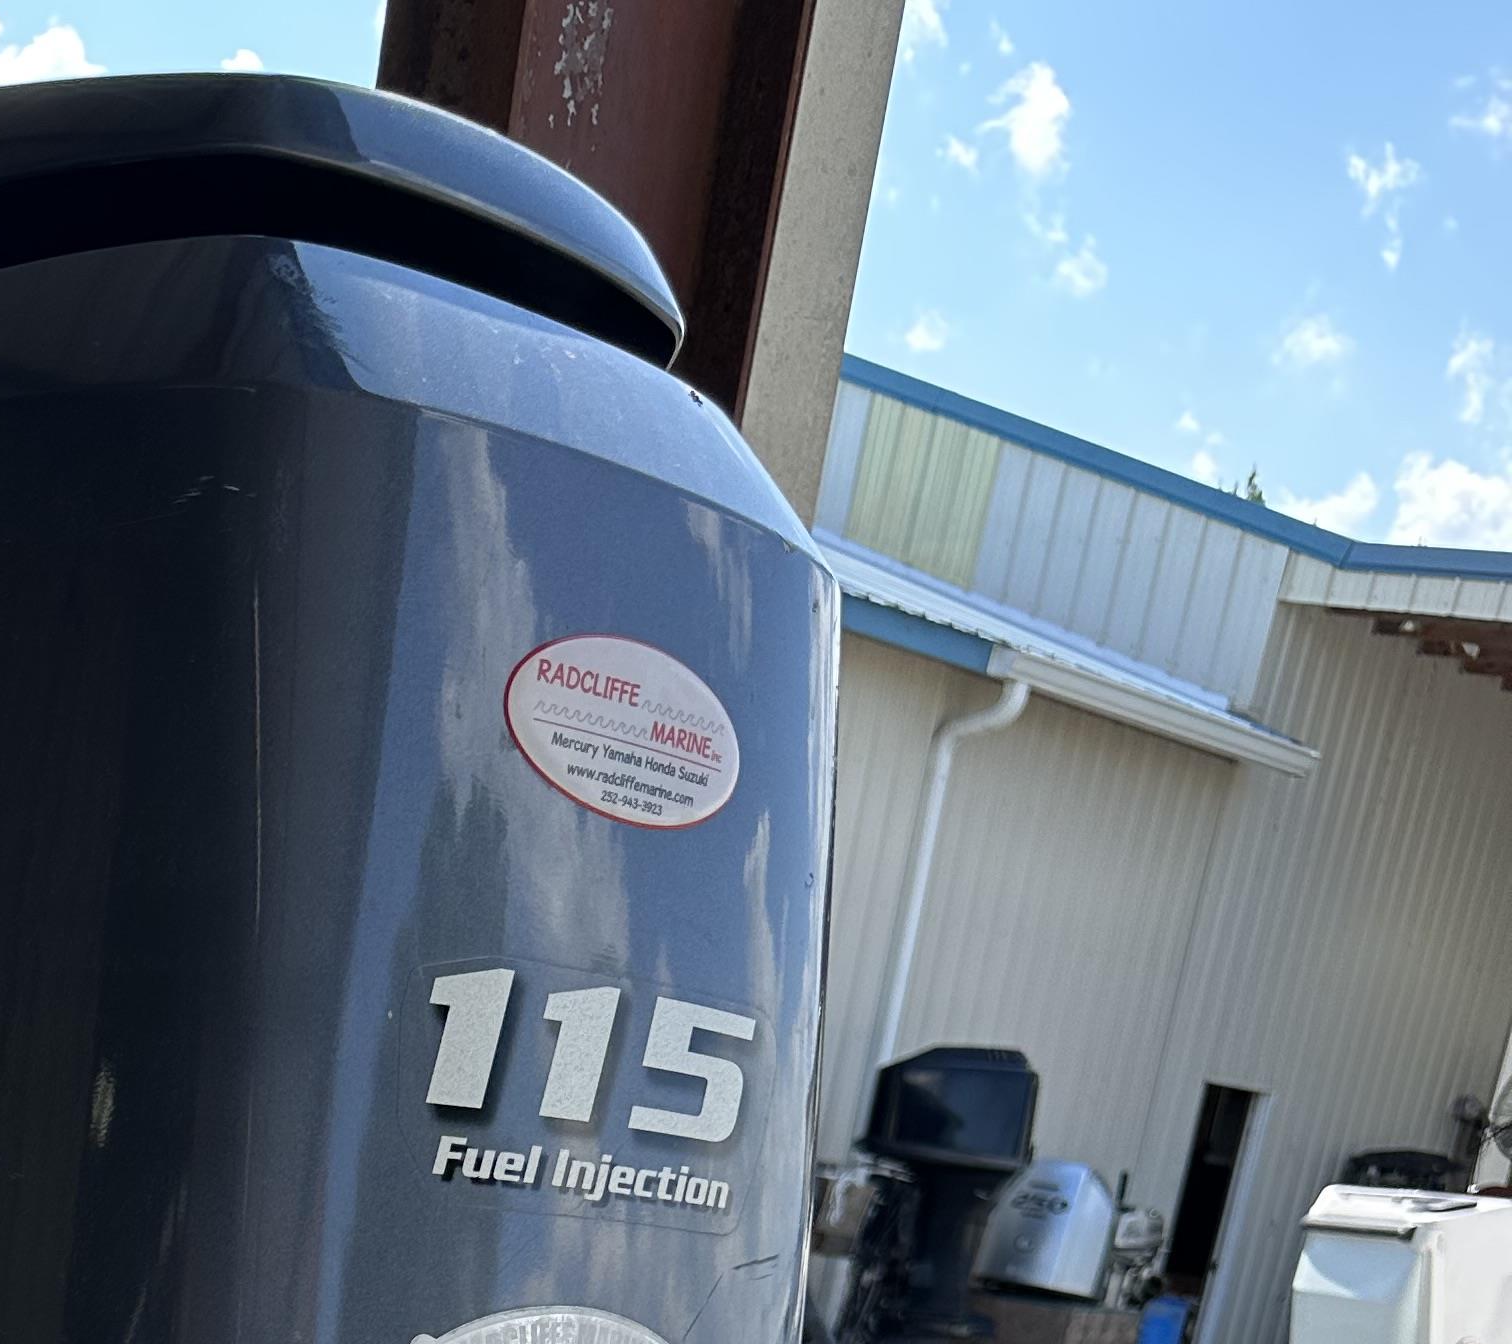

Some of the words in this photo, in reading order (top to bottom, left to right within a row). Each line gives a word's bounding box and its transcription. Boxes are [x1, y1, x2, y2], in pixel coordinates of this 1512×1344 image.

[537, 659, 640, 707] RADCLIFFE
[550, 731, 599, 759] Mercury
[602, 744, 643, 768] Yamaha
[645, 758, 676, 778] Honda
[678, 766, 709, 787] Suzuki
[649, 721, 713, 759] MARINE
[566, 761, 695, 808] www.radcliffemarine.com
[600, 789, 664, 817] 252-943-3923
[425, 968, 756, 1143] 115
[432, 1135, 543, 1185] Fuel
[551, 1149, 731, 1210] Injection
